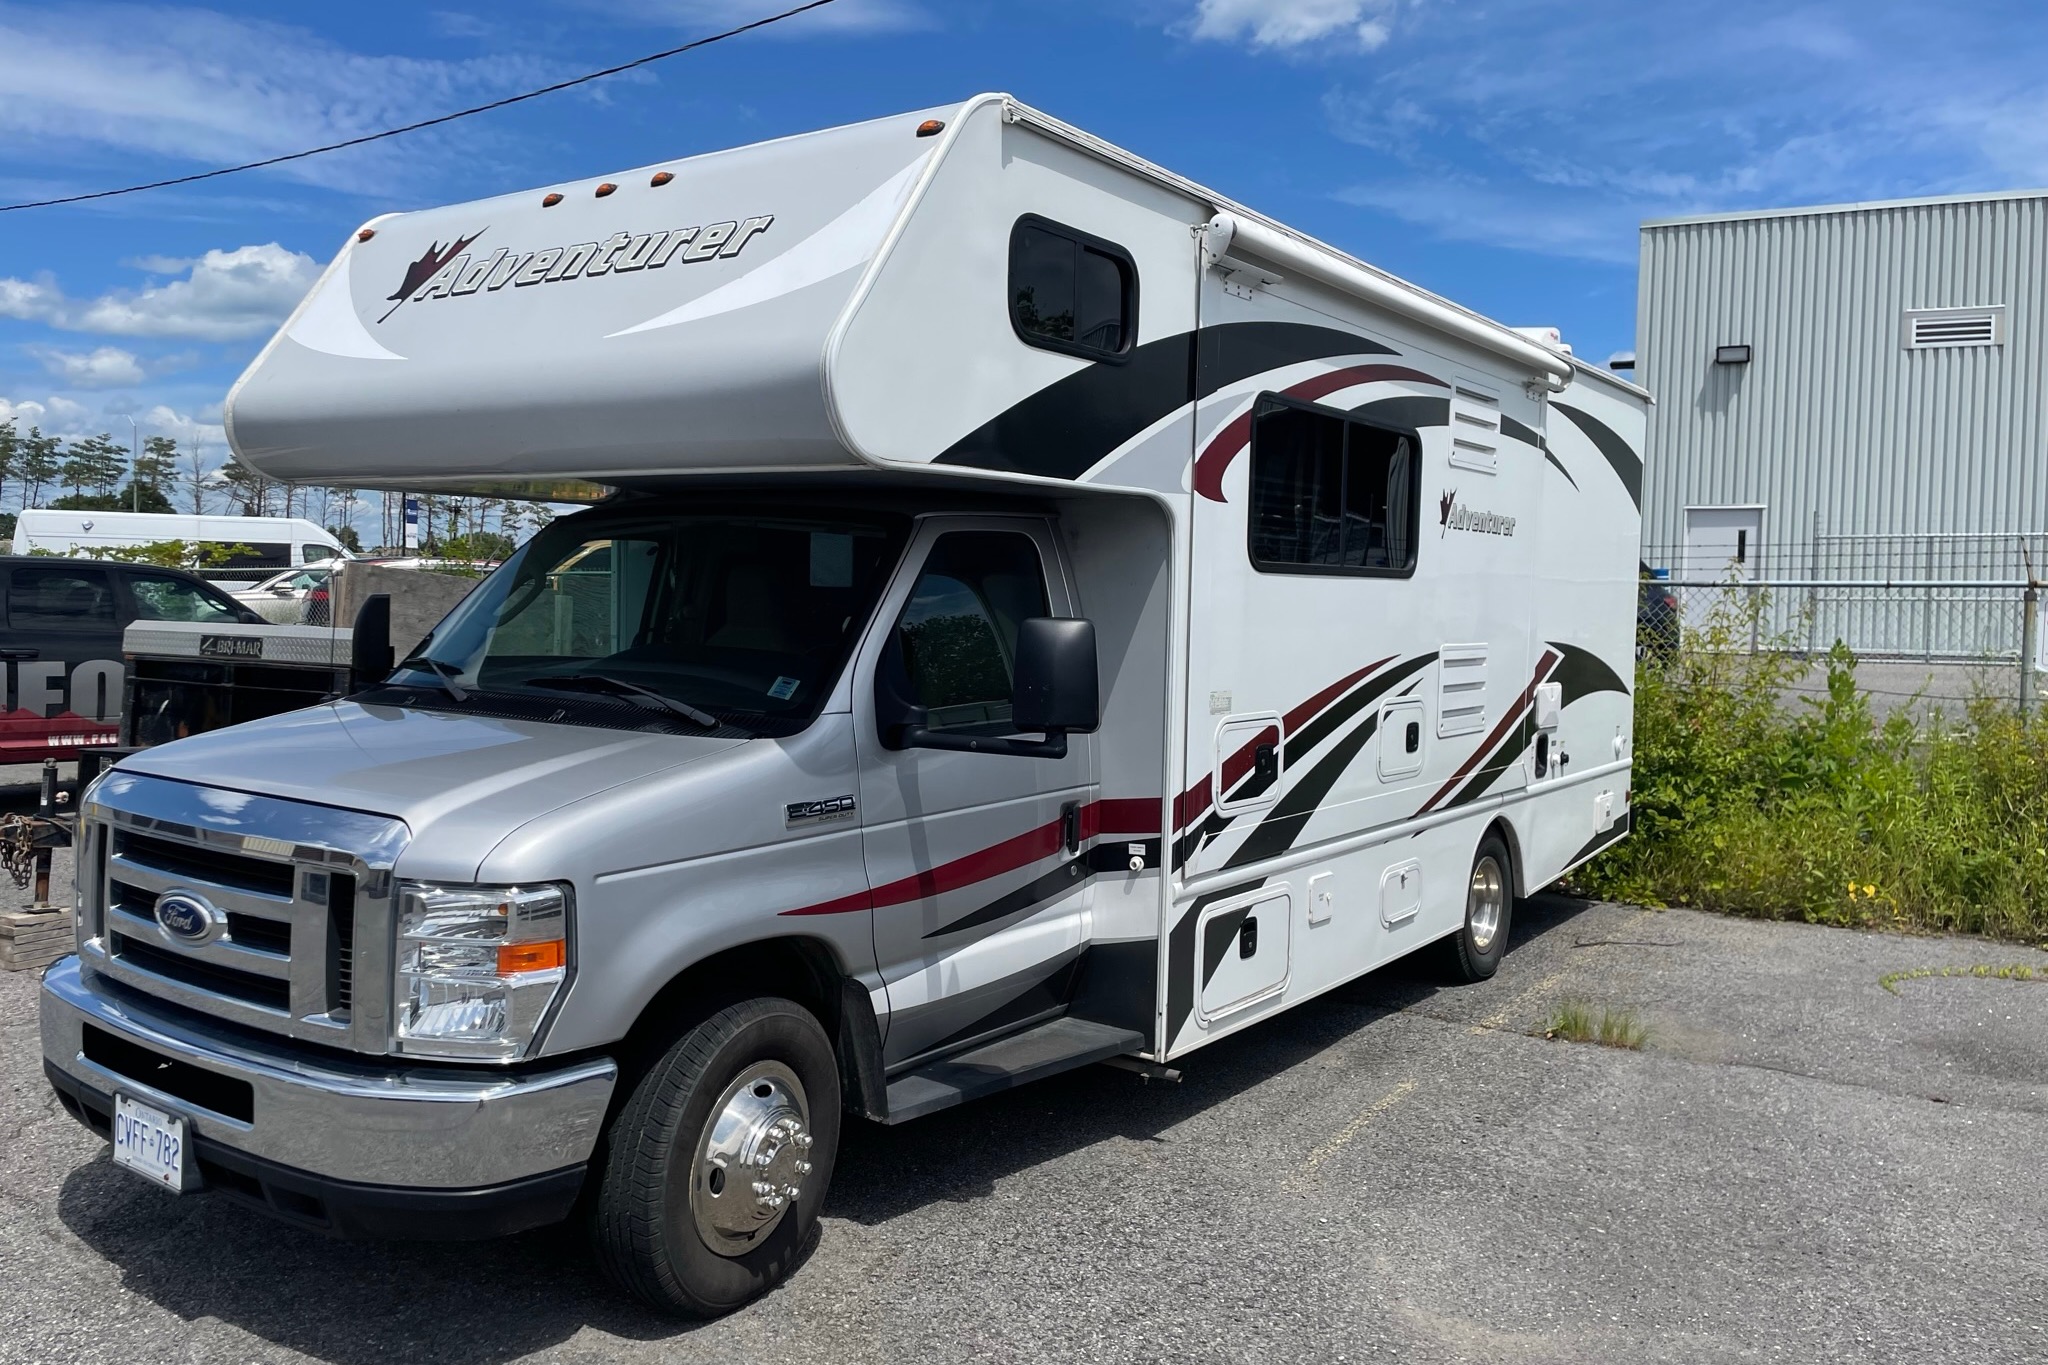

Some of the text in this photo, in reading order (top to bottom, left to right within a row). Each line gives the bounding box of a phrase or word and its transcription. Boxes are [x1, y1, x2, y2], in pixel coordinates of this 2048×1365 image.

[412, 214, 775, 302] Adventurer
[1448, 502, 1516, 537] Adventurer
[818, 813, 838, 822] SUPER
[164, 903, 194, 931] Ford
[117, 1113, 149, 1156] CVFF
[156, 1128, 180, 1171] 782
